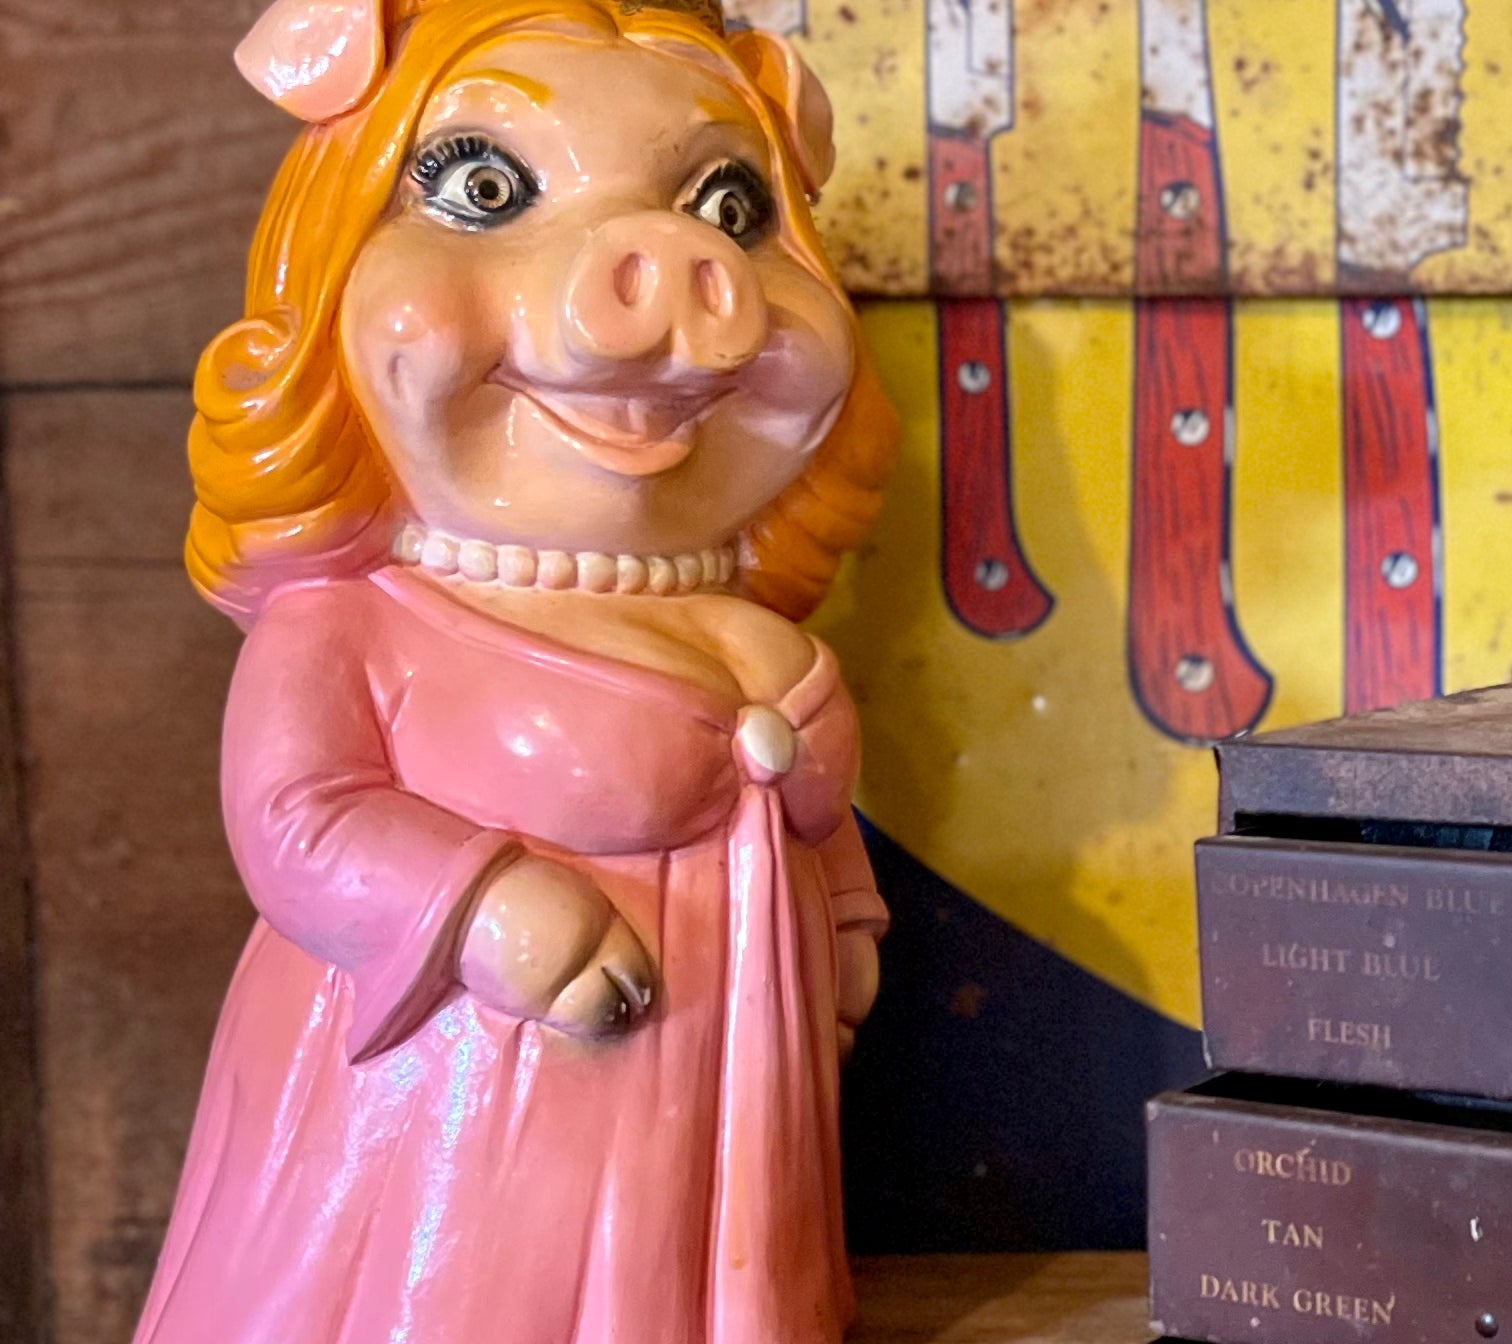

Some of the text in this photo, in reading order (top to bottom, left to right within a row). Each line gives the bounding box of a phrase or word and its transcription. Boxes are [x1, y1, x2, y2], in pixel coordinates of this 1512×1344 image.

[1426, 890, 1505, 916] BLUE
[1262, 943, 1441, 981] LIGHT BLUE
[1307, 1018, 1392, 1050] FLESH
[1233, 1147, 1352, 1187] ORCHID
[1262, 1219, 1325, 1249] TAN
[1201, 1274, 1392, 1325] DARK GREEN
